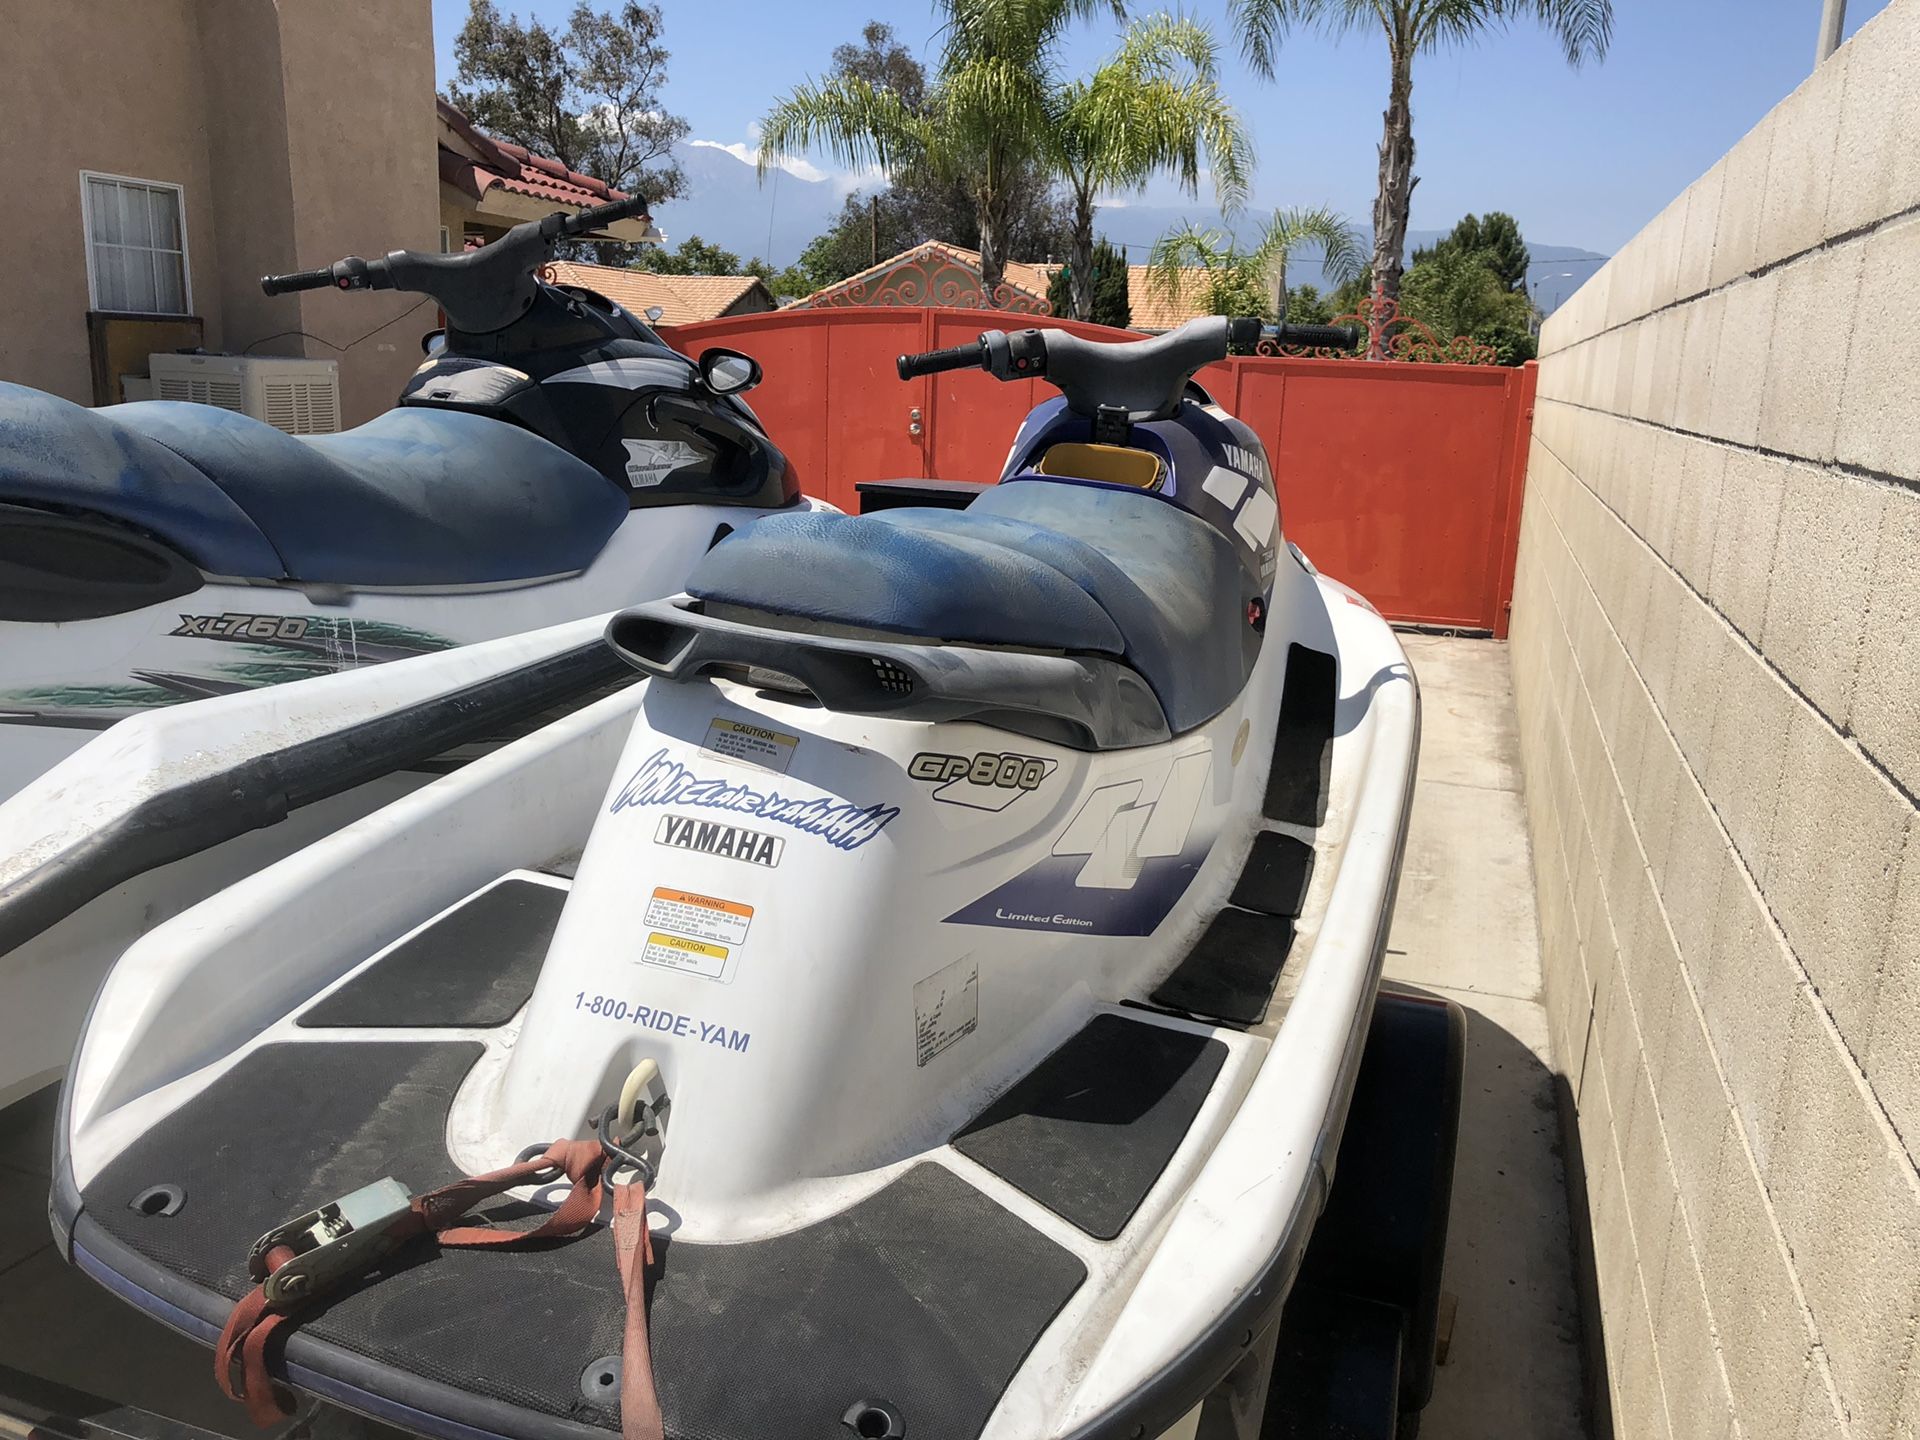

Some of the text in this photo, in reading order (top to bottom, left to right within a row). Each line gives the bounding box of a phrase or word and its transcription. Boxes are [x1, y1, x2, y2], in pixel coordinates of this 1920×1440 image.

[1221, 443, 1264, 483] YAMAHA
[170, 612, 309, 639] XL760
[732, 723, 775, 741] CAUTION
[907, 752, 1045, 790] GP800
[757, 791, 900, 850] YAMAHA
[664, 816, 775, 866] YAMAHA
[687, 895, 725, 910] WARNING
[995, 908, 1093, 927] Limited Edition
[669, 938, 706, 953] CAUTION
[575, 991, 751, 1053] 1-800-RIDE-YAM
